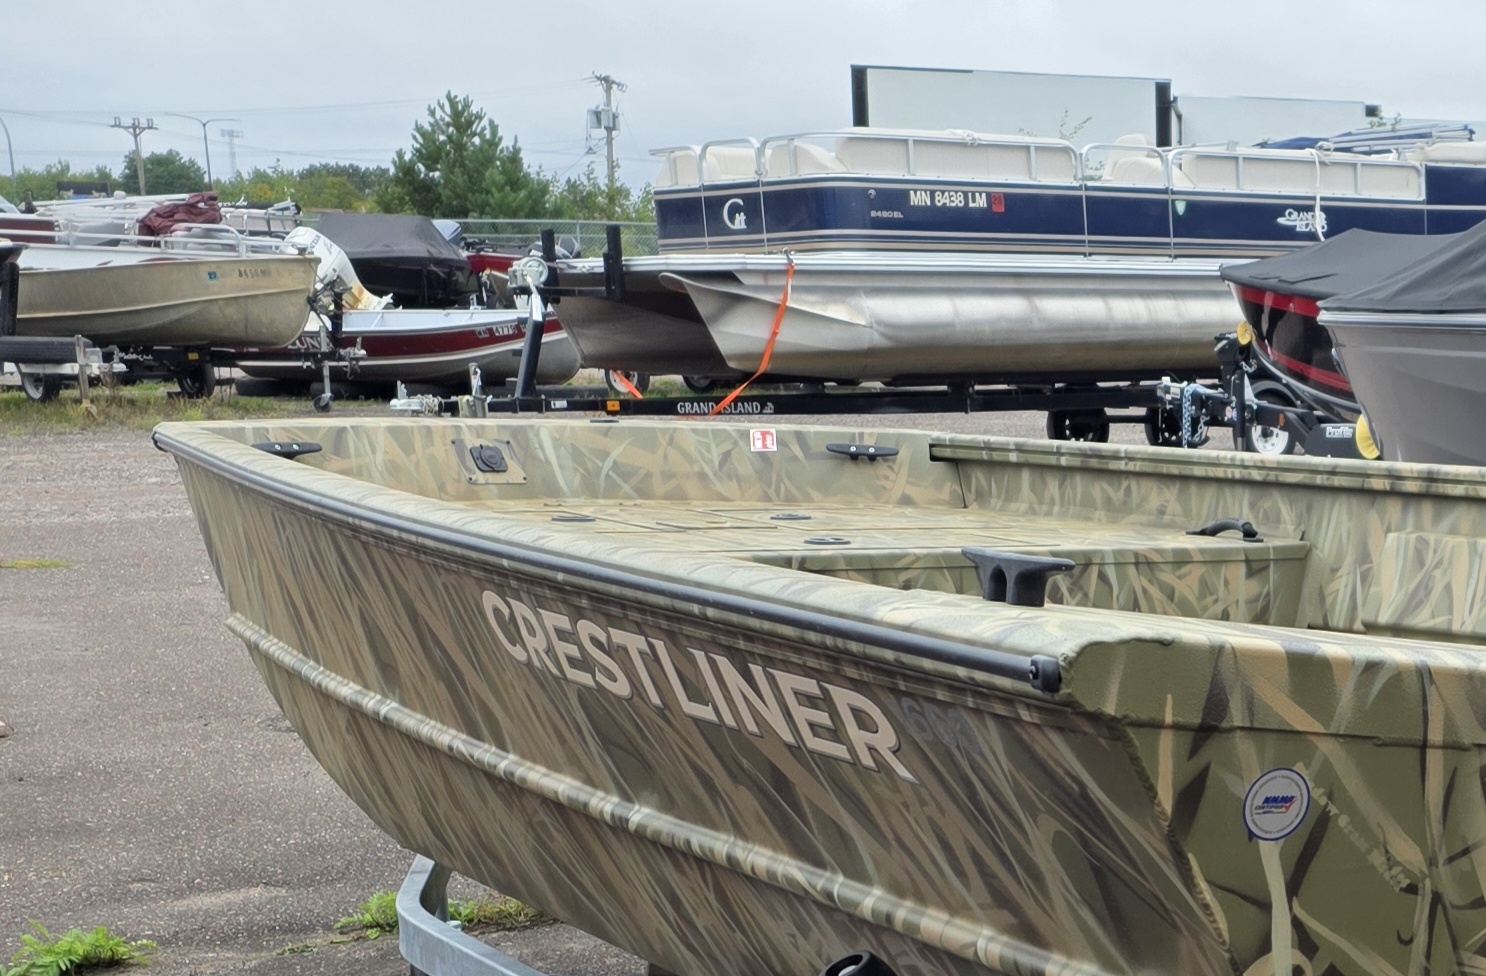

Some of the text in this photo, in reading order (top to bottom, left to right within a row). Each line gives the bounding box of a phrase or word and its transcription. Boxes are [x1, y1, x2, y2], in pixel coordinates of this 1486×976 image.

[909, 190, 987, 207] MN 8438 LM
[1296, 221, 1328, 232] ISLAD
[677, 402, 717, 414] GRAND
[1326, 426, 1354, 438] Profile
[482, 589, 920, 785] CRESTLINER
